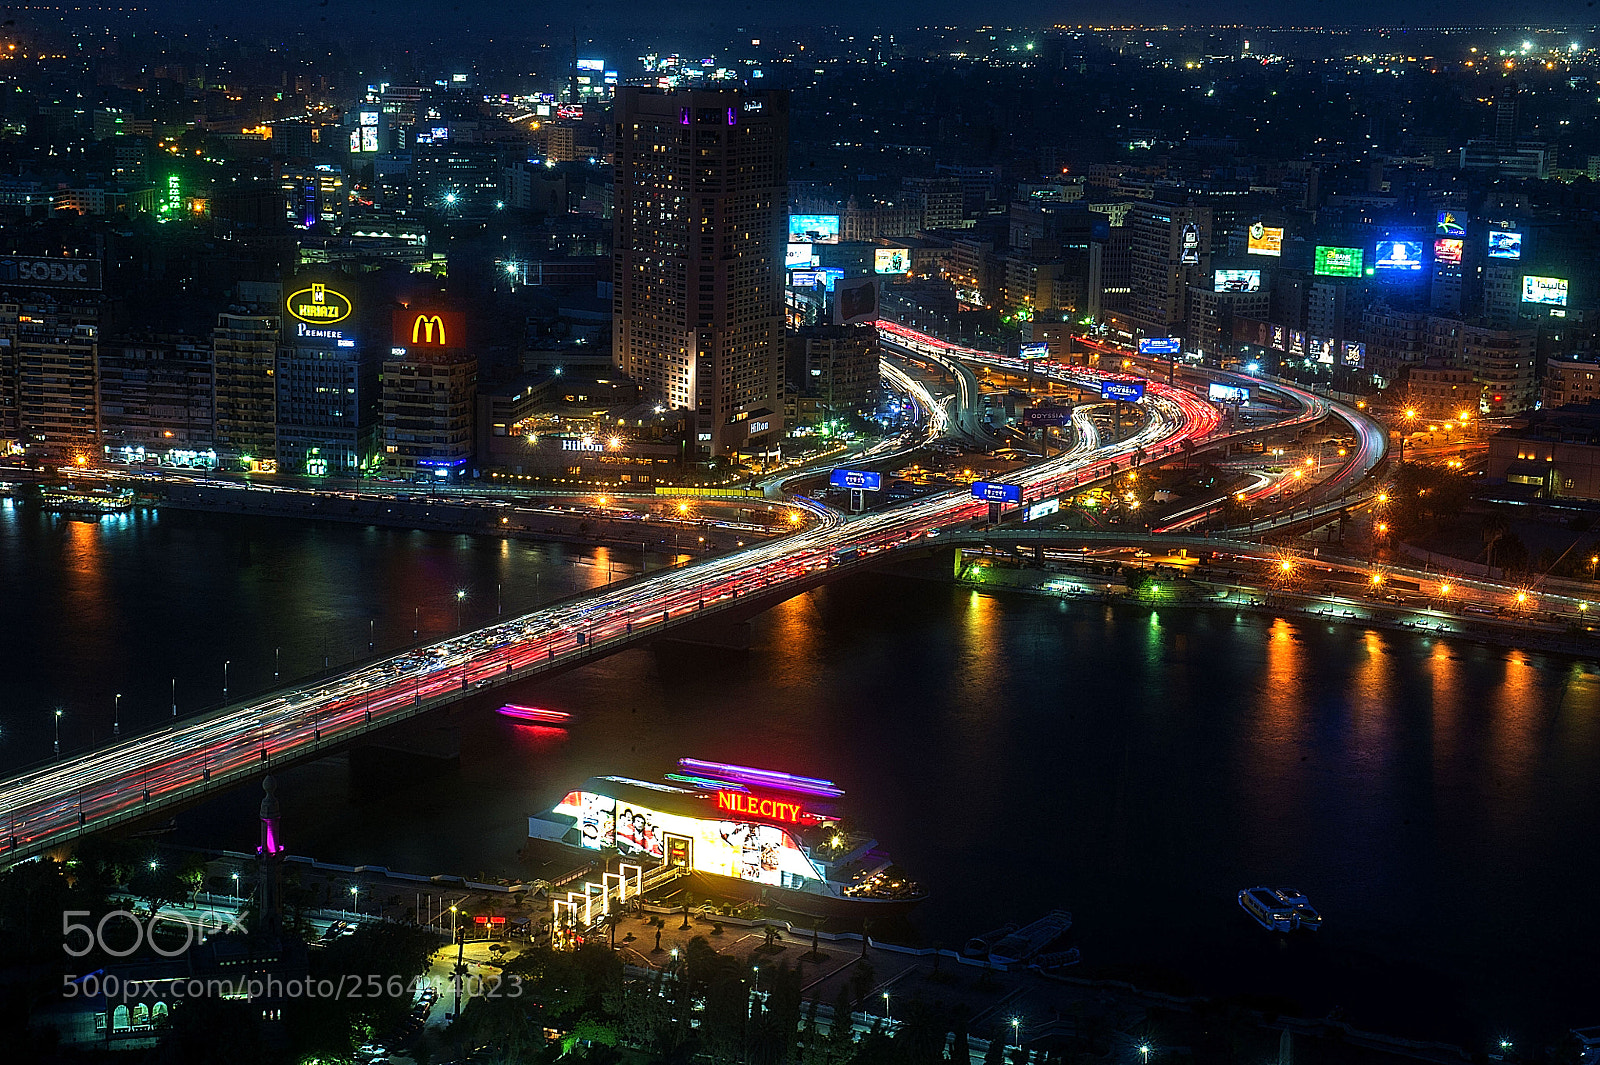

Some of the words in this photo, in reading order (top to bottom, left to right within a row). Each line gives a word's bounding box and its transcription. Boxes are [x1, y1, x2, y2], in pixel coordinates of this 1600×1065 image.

[19, 260, 88, 283] SODIC
[1031, 412, 1065, 420] ODYSSIA
[750, 421, 770, 435] Hilton
[562, 439, 604, 452] Hilton
